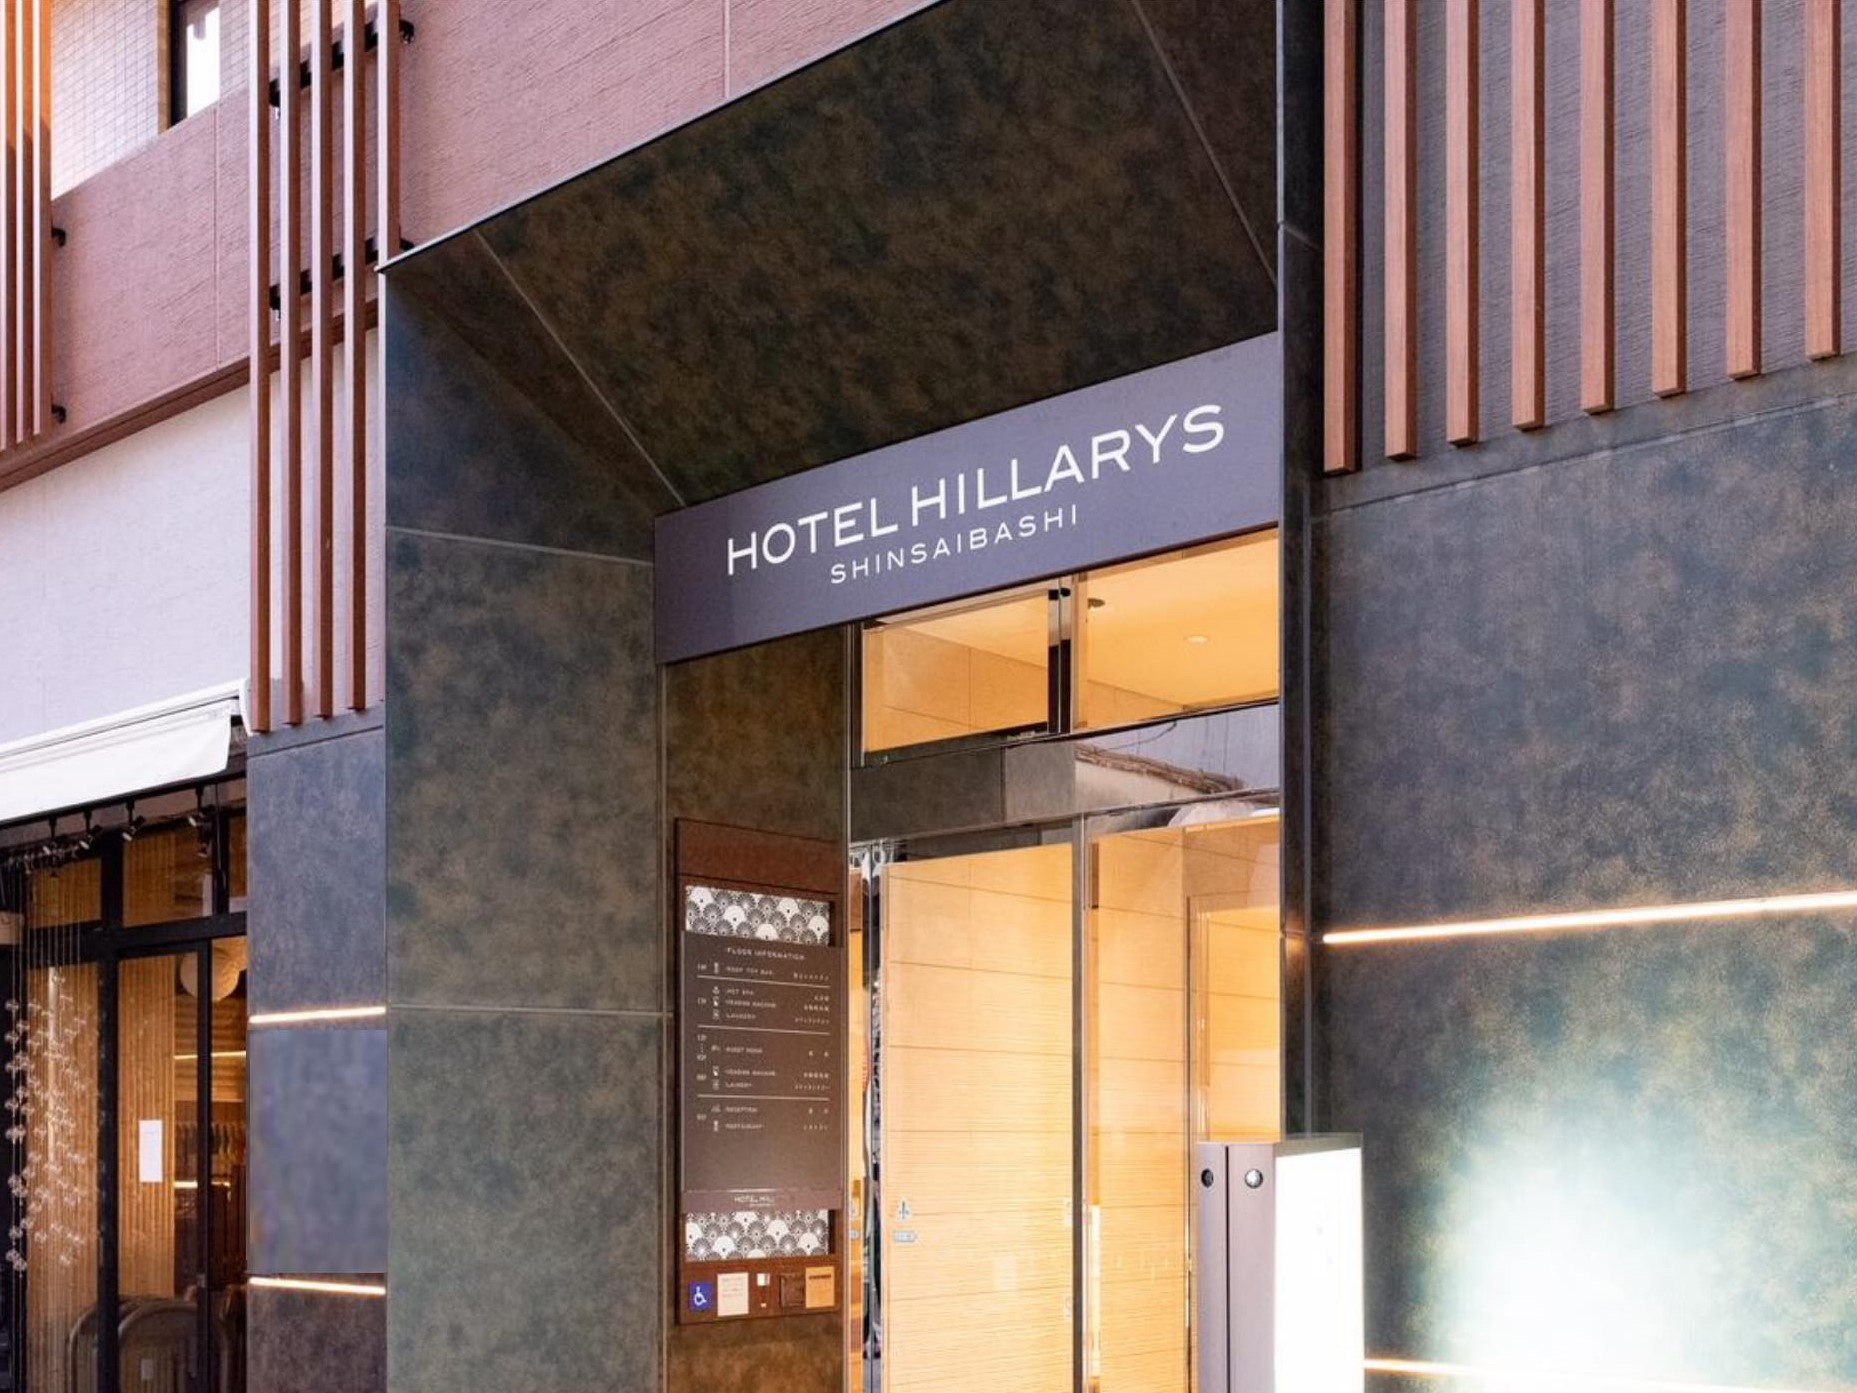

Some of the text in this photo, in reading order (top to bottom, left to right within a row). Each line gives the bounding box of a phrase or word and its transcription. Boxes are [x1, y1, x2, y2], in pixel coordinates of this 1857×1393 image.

[726, 403, 1225, 576] HOTEL HILLARYS
[829, 503, 1079, 586] SHINSAIBASHI
